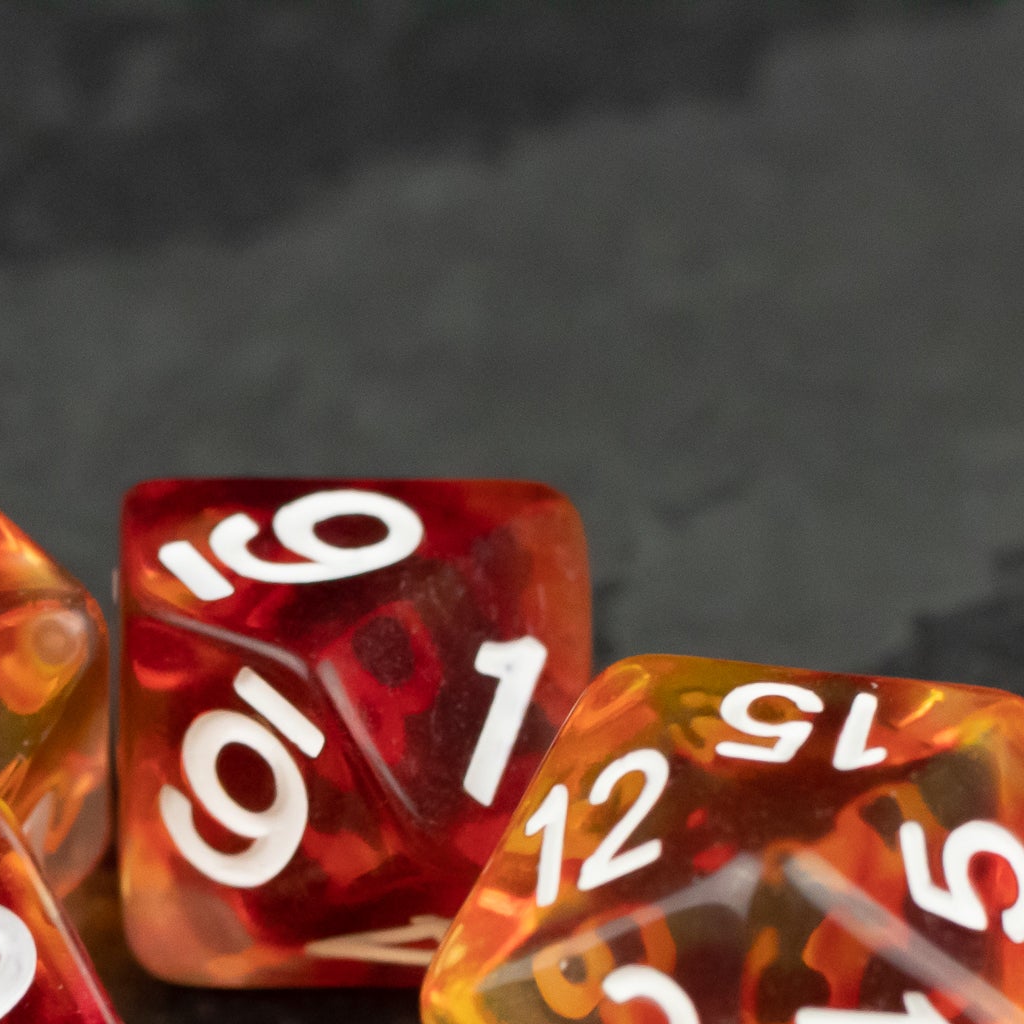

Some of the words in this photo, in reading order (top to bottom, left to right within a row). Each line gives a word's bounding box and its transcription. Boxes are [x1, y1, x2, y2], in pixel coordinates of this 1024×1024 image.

[463, 636, 548, 807] 1
[715, 682, 886, 770] 15
[525, 748, 669, 907] 12
